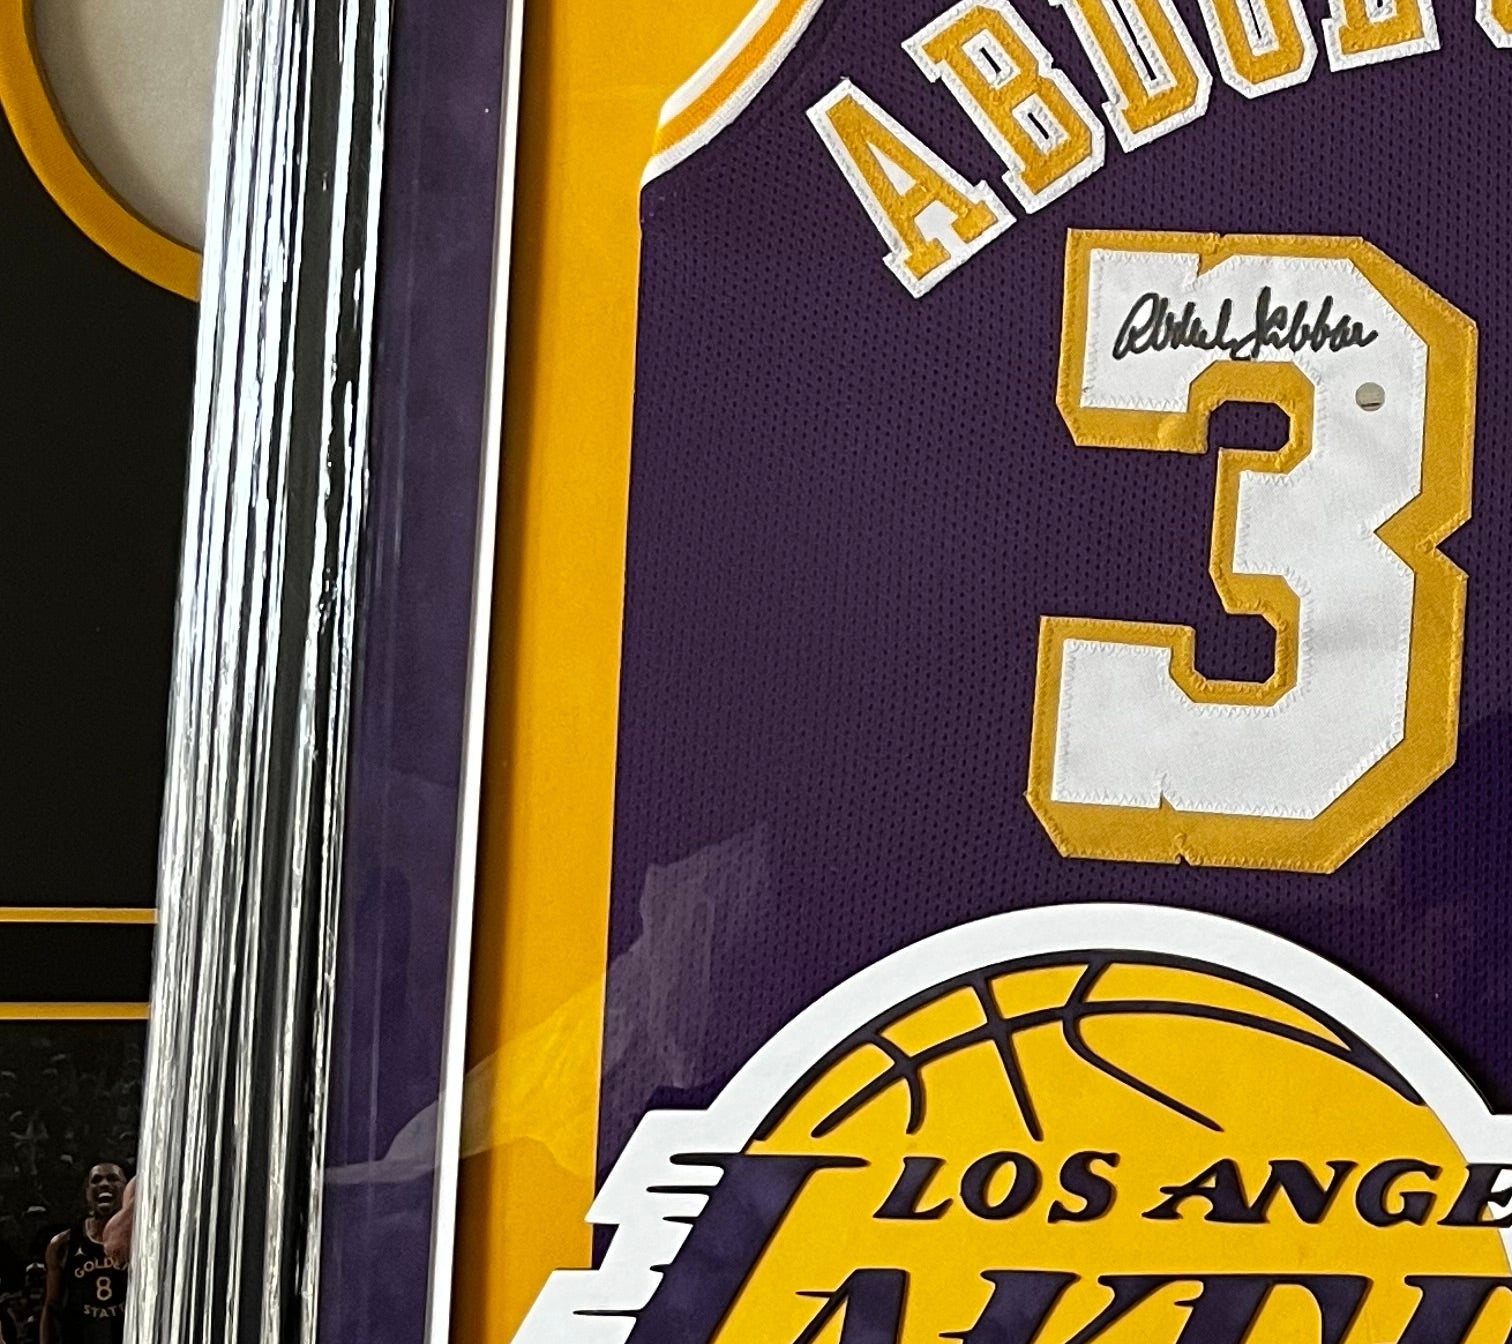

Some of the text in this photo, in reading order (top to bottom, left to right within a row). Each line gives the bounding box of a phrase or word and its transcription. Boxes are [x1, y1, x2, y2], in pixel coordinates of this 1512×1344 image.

[873, 1152, 1122, 1224] LOS
[74, 1256, 129, 1278] GOLD
[96, 1276, 112, 1301] 8
[83, 1303, 126, 1318] STAT
